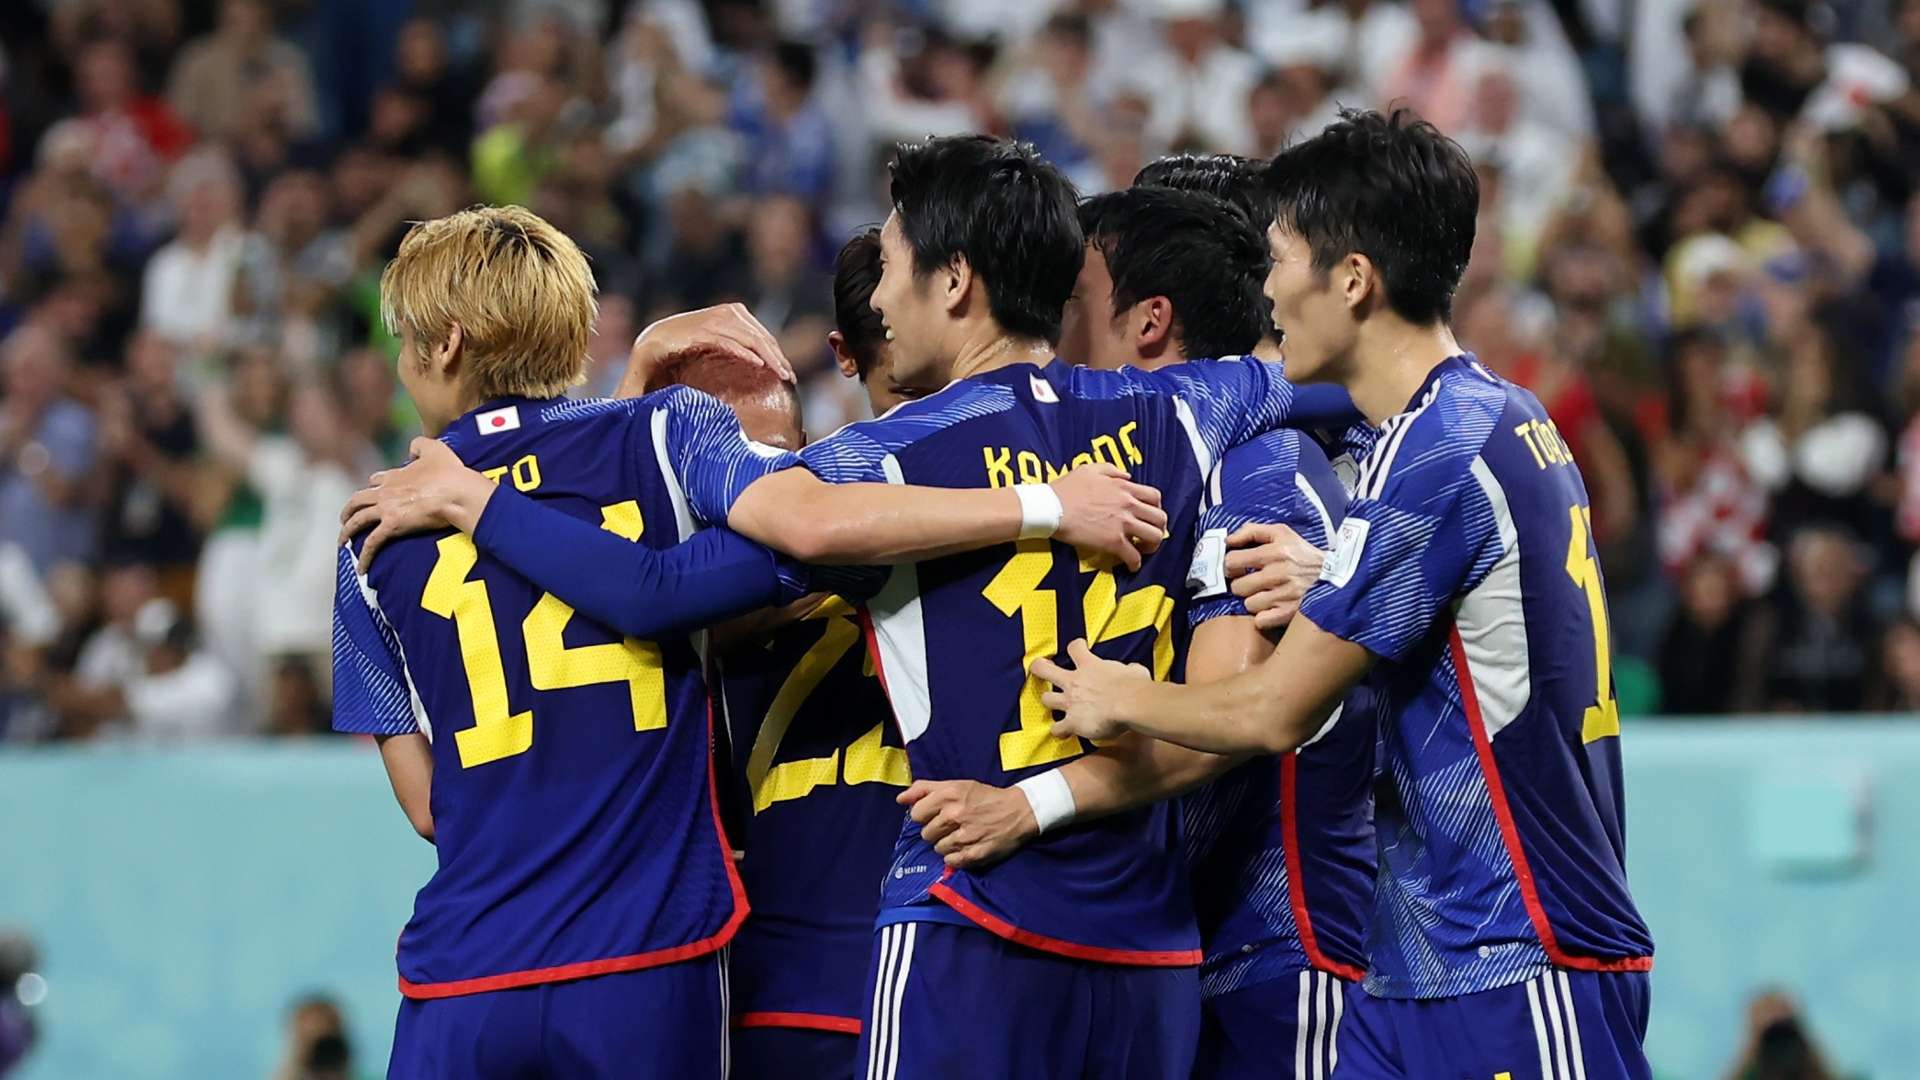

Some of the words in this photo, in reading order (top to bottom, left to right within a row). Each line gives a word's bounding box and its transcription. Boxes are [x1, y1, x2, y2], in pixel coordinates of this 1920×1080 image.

[481, 454, 542, 492] TO
[421, 500, 667, 769] 14
[1565, 504, 1620, 745] 1
